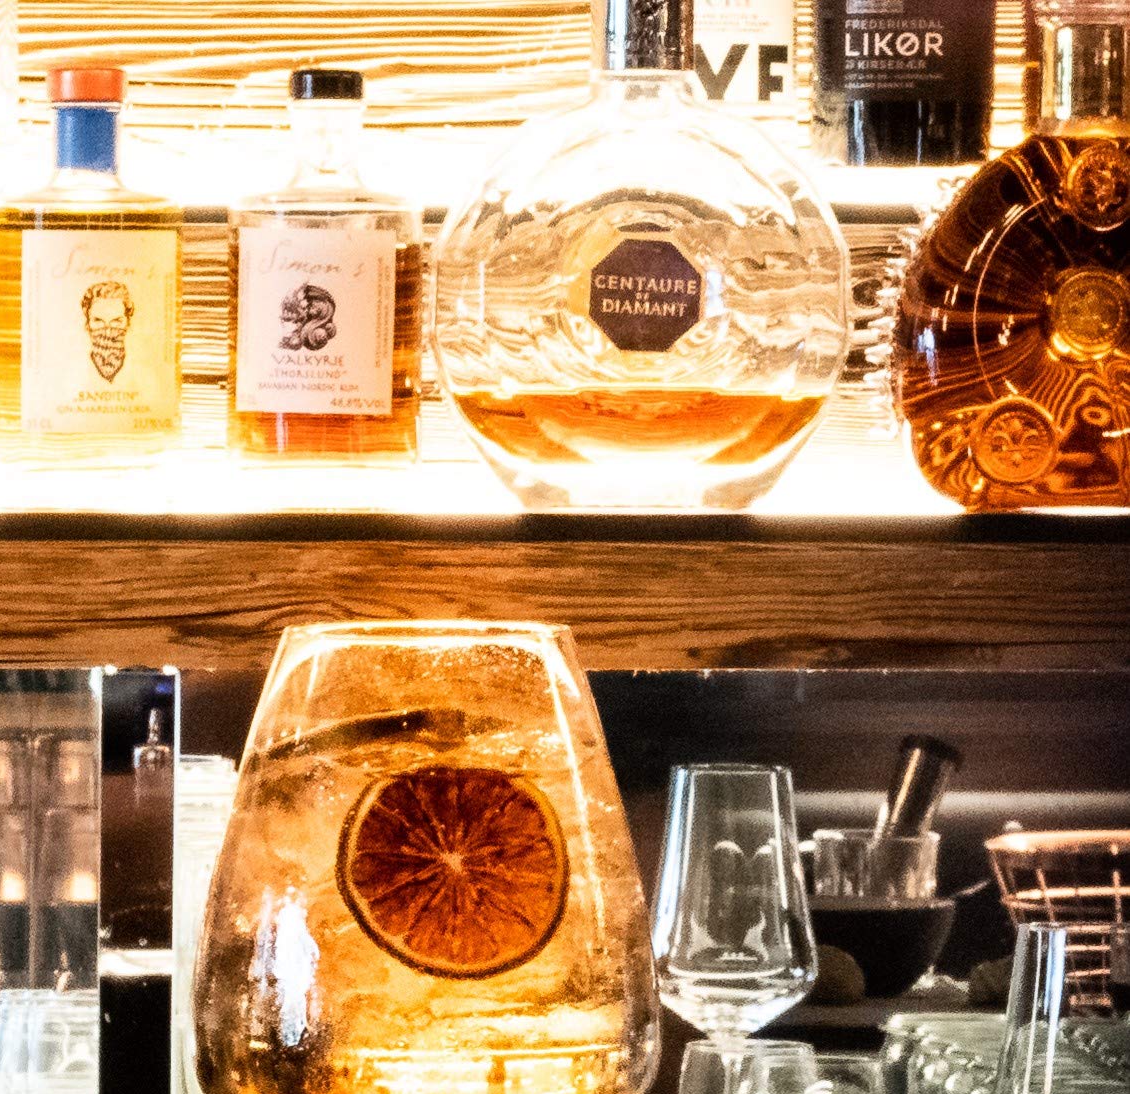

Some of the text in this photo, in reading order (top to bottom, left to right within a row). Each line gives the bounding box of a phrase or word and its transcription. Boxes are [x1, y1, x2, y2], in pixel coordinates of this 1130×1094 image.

[844, 31, 944, 57] LIKØR
[594, 274, 698, 295] CENTAURE
[601, 298, 688, 317] DIAMANT
